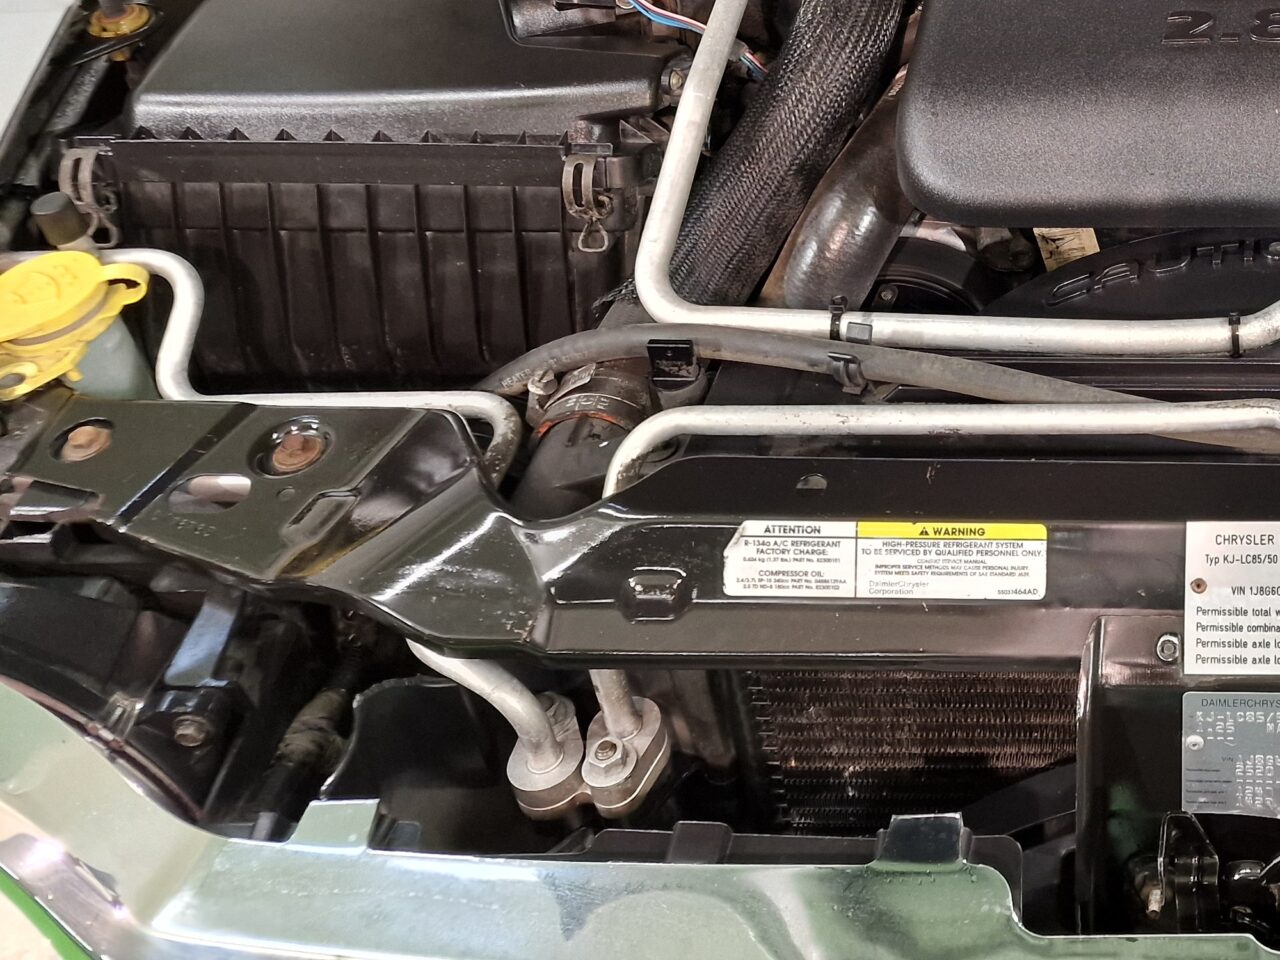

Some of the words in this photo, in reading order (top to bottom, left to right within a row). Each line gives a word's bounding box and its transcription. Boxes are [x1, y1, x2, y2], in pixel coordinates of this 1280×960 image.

[764, 525, 821, 535] ATTENTION
[933, 527, 985, 536] WARNING
[790, 540, 841, 548] REFRIGERANT
[1215, 534, 1275, 545] CHRYSLER
[885, 548, 920, 556] SERVICED
[1205, 554, 1220, 566] Typ
[1223, 554, 1278, 564] KJ-LC85/50
[810, 570, 824, 578] OIL:
[1231, 586, 1246, 596] VIN
[1196, 606, 1248, 617] Permissible
[1252, 607, 1271, 616] total
[1196, 622, 1243, 632] Permissible
[1195, 638, 1248, 648] Permissible
[1251, 638, 1271, 648] axle
[1195, 654, 1248, 665] Permissible
[1251, 654, 1271, 665] axle
[1235, 765, 1274, 776] 2520
